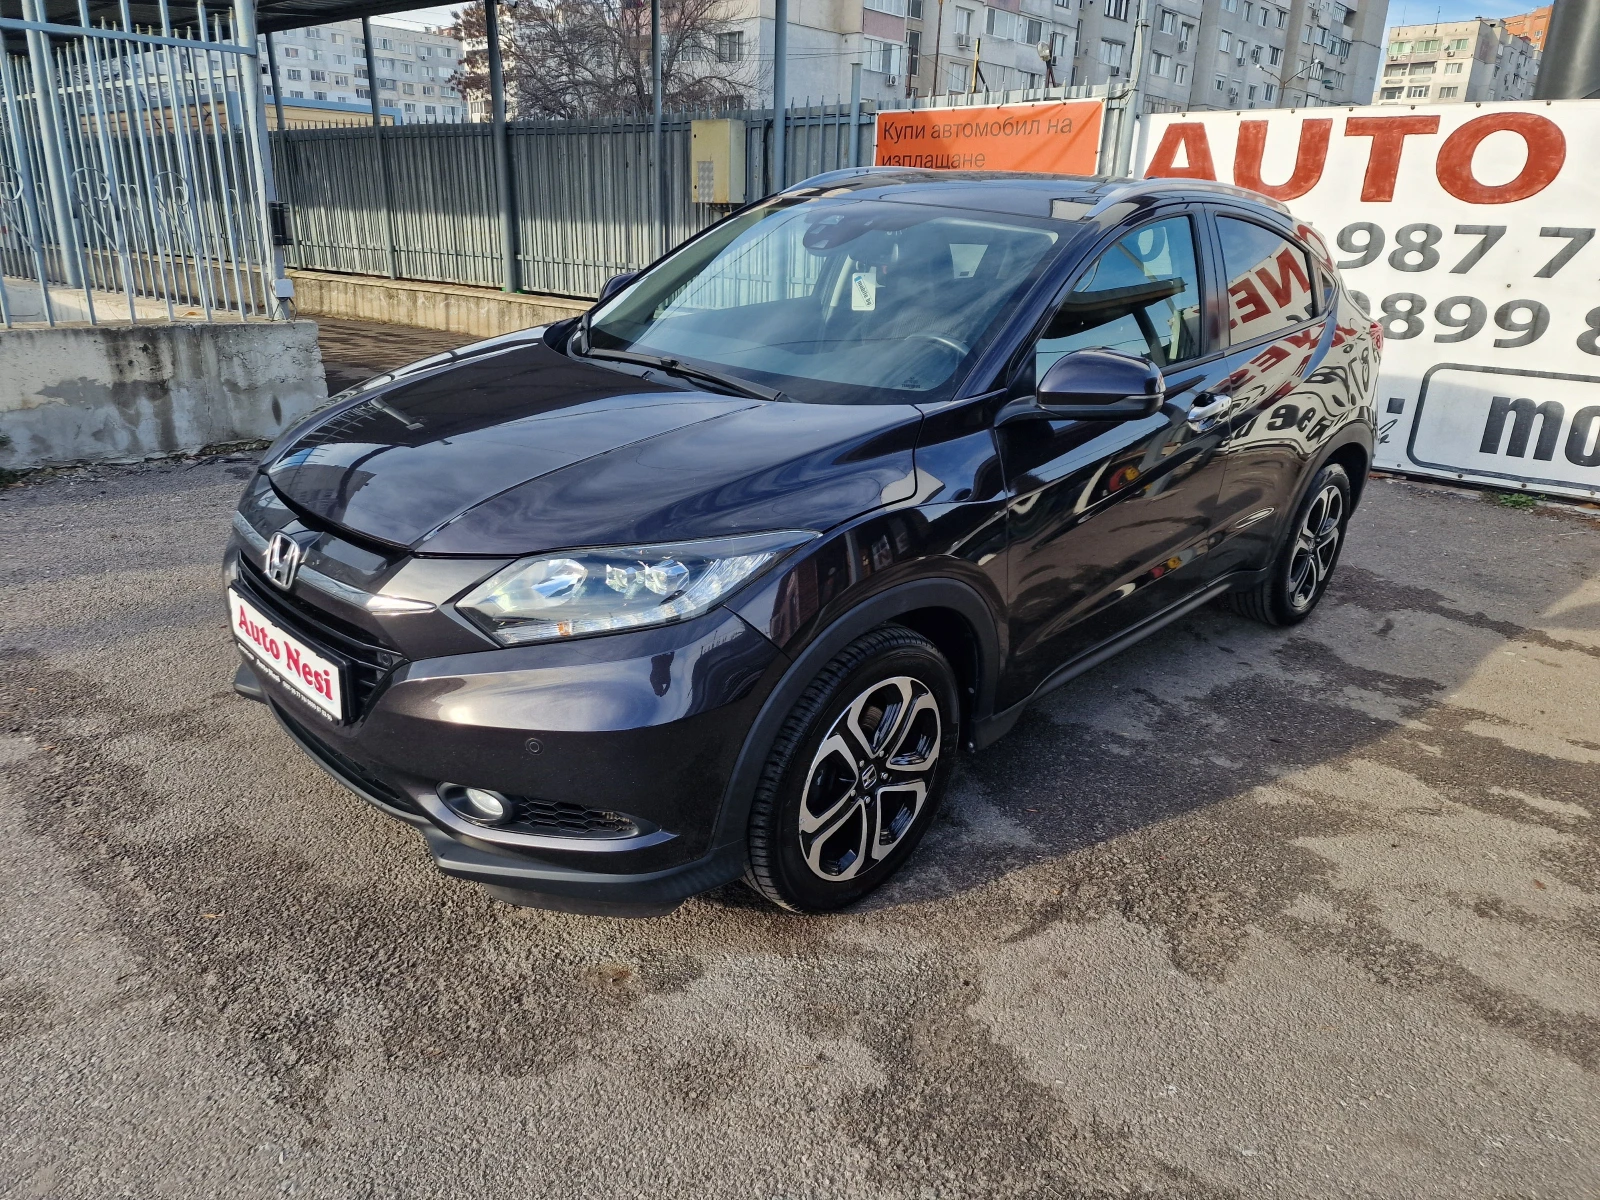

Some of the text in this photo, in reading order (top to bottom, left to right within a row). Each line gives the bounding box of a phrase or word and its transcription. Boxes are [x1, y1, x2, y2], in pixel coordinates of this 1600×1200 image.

[883, 116, 1073, 144] Купи автомобил на
[882, 152, 986, 169] изплащане
[1143, 112, 1567, 204] AUTO
[1533, 227, 1600, 281] 7
[238, 605, 280, 660] Auto
[283, 640, 334, 701] Nesi
